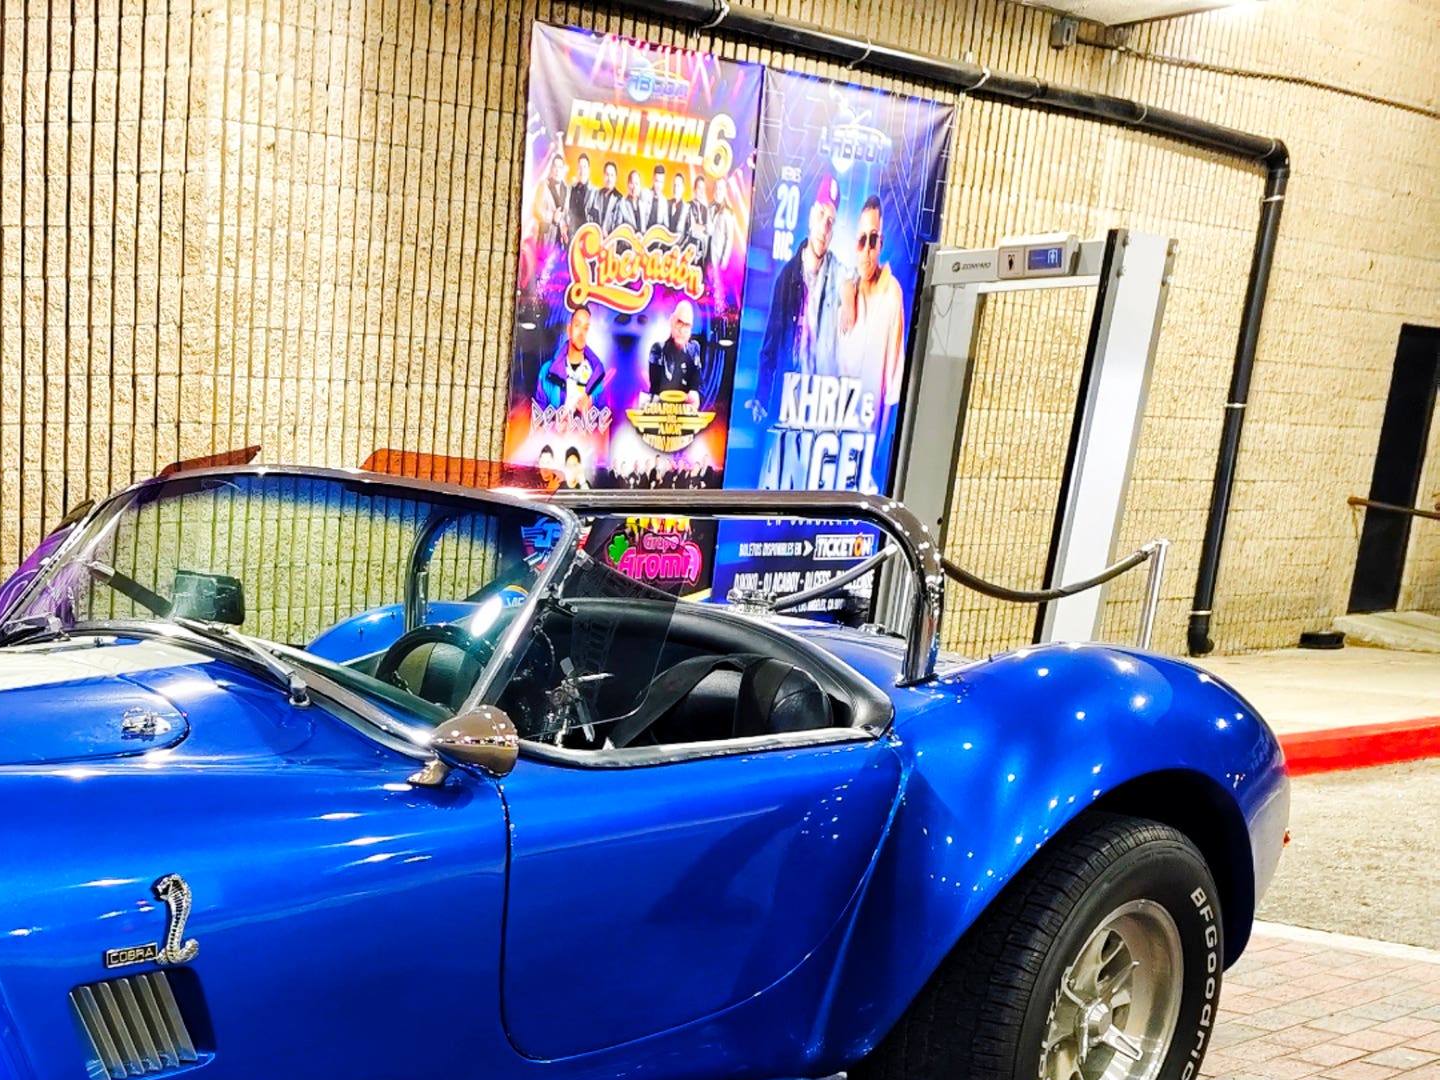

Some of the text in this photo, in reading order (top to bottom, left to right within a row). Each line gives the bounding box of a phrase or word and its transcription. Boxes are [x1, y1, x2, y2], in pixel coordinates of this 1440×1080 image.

[565, 99, 736, 179] FIESTA TOTAL 6
[774, 183, 800, 231] 20
[566, 223, 706, 314] Liberación
[779, 373, 863, 428] KHRIZ
[643, 533, 680, 552] Grupo
[109, 946, 155, 964] COBRA
